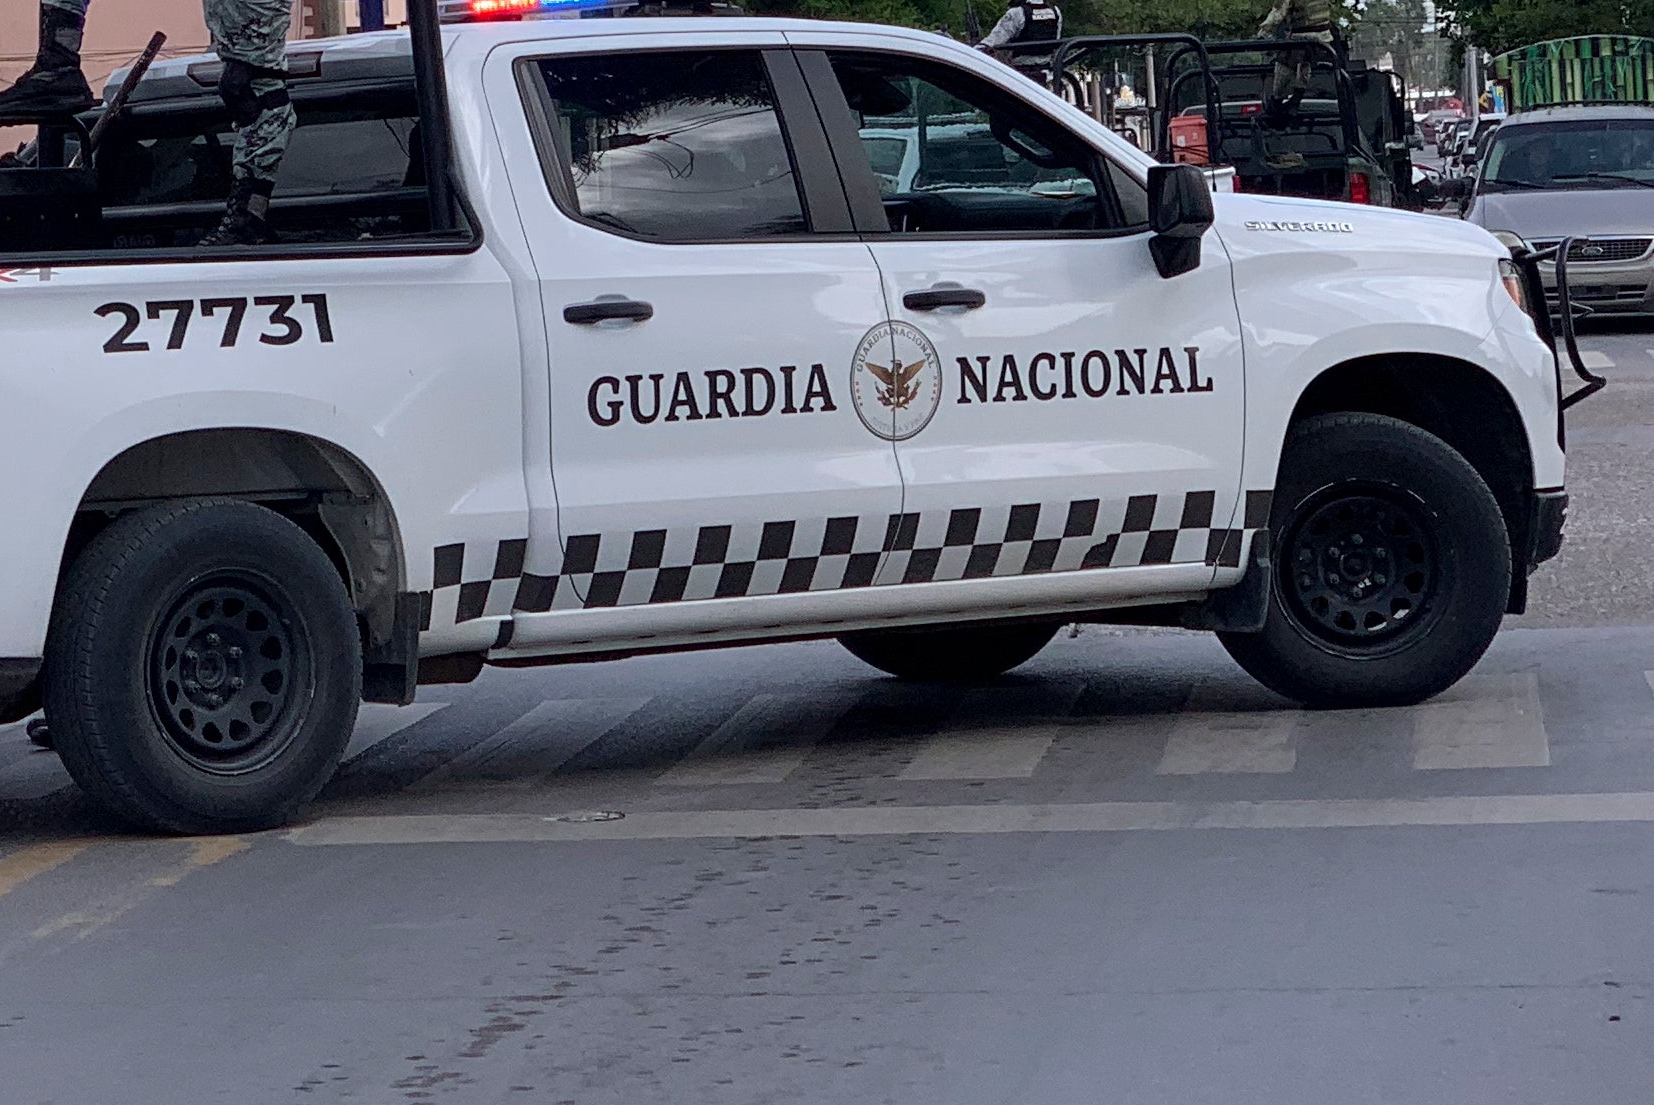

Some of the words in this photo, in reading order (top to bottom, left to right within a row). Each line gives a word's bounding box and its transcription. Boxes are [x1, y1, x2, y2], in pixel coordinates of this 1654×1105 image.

[1244, 220, 1354, 233] SILVERADO
[93, 293, 334, 354] 27731
[856, 328, 891, 373] GUARDIA
[891, 326, 936, 369] NACIONAL
[587, 363, 838, 427] GUARDIA
[955, 346, 1214, 406] NACIONAL
